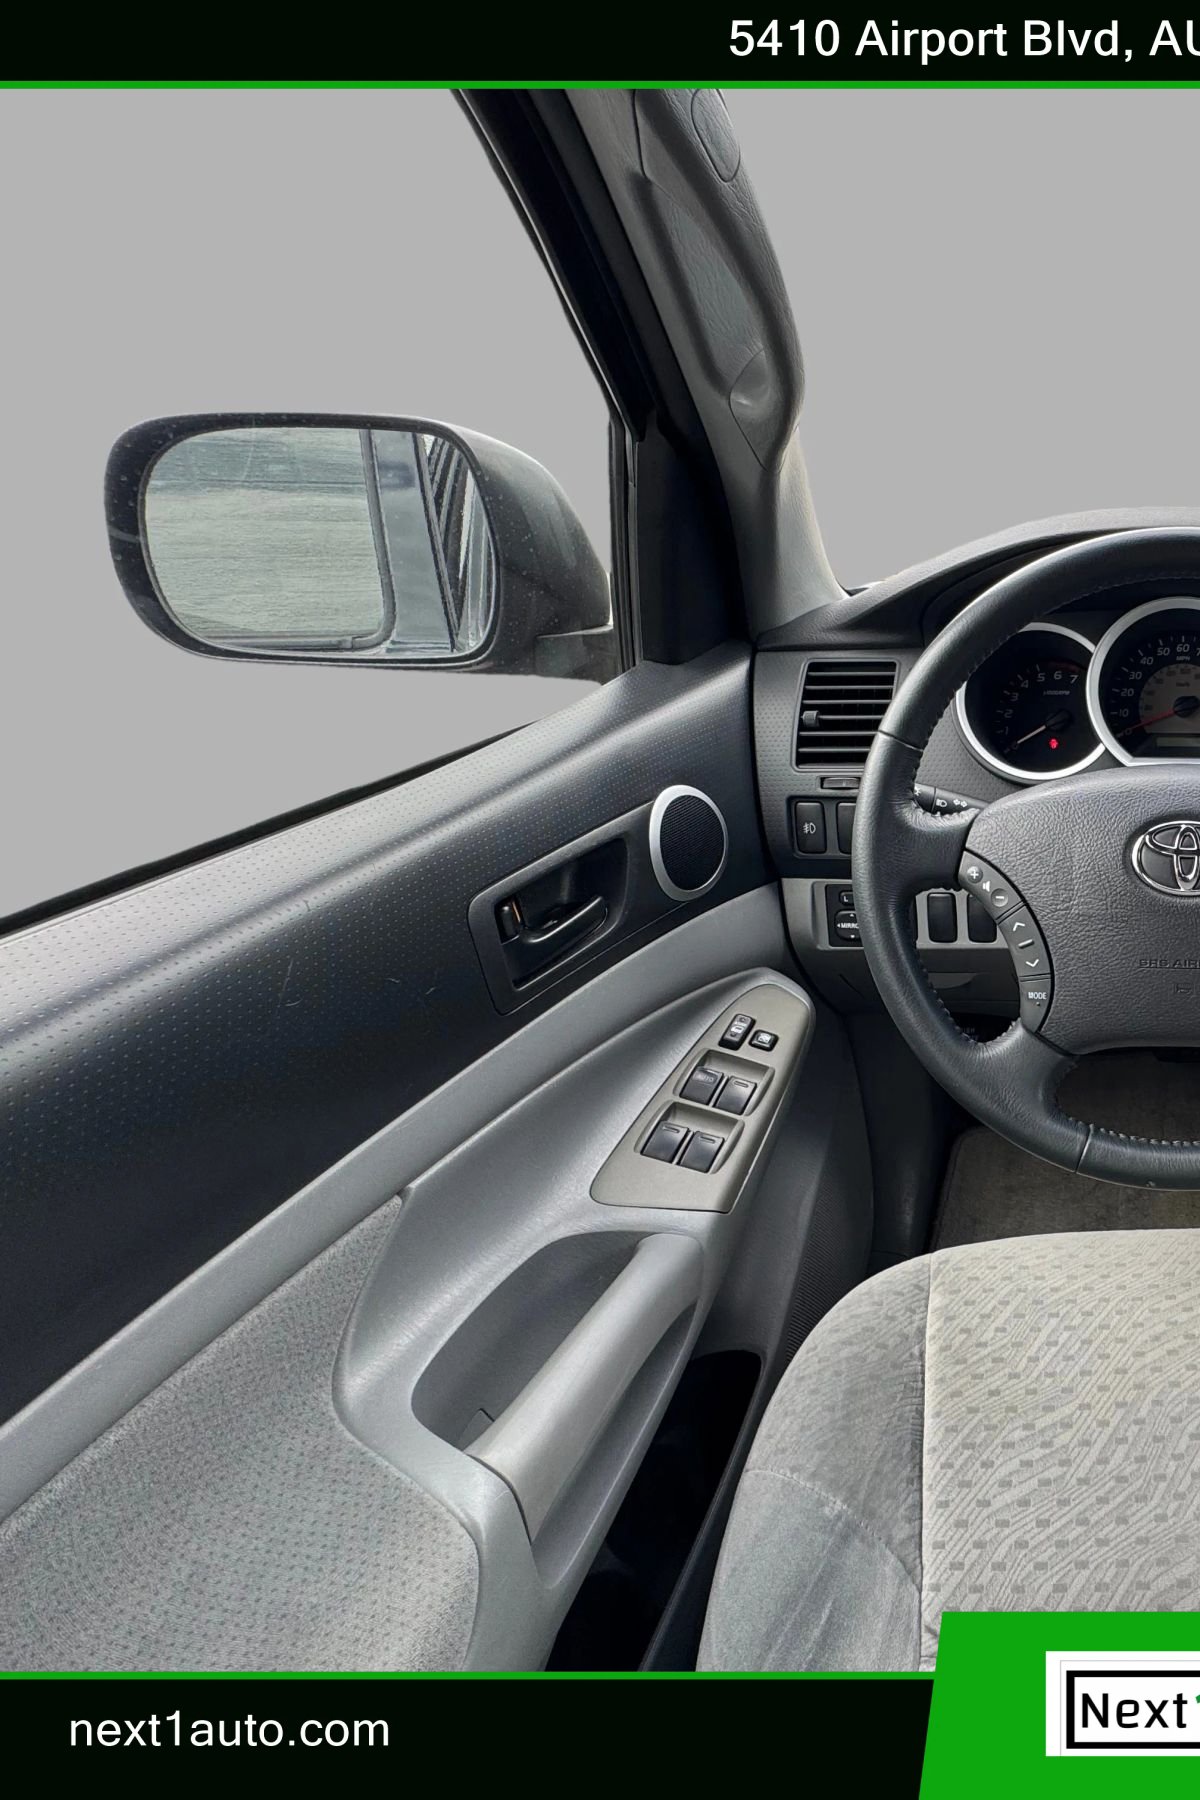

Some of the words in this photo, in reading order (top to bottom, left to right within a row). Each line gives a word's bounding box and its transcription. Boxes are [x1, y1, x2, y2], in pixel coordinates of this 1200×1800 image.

[1157, 647, 1170, 656] 50
[1176, 643, 1190, 653] 60
[1140, 656, 1154, 665] 40
[1036, 673, 1046, 682] 5
[1053, 671, 1062, 680] 6
[1070, 674, 1079, 684] 7
[1129, 671, 1142, 680] 30
[1120, 688, 1134, 697] 20
[1119, 709, 1129, 717] 10
[1138, 959, 1169, 969] SRS
[1028, 991, 1047, 1000] MODE
